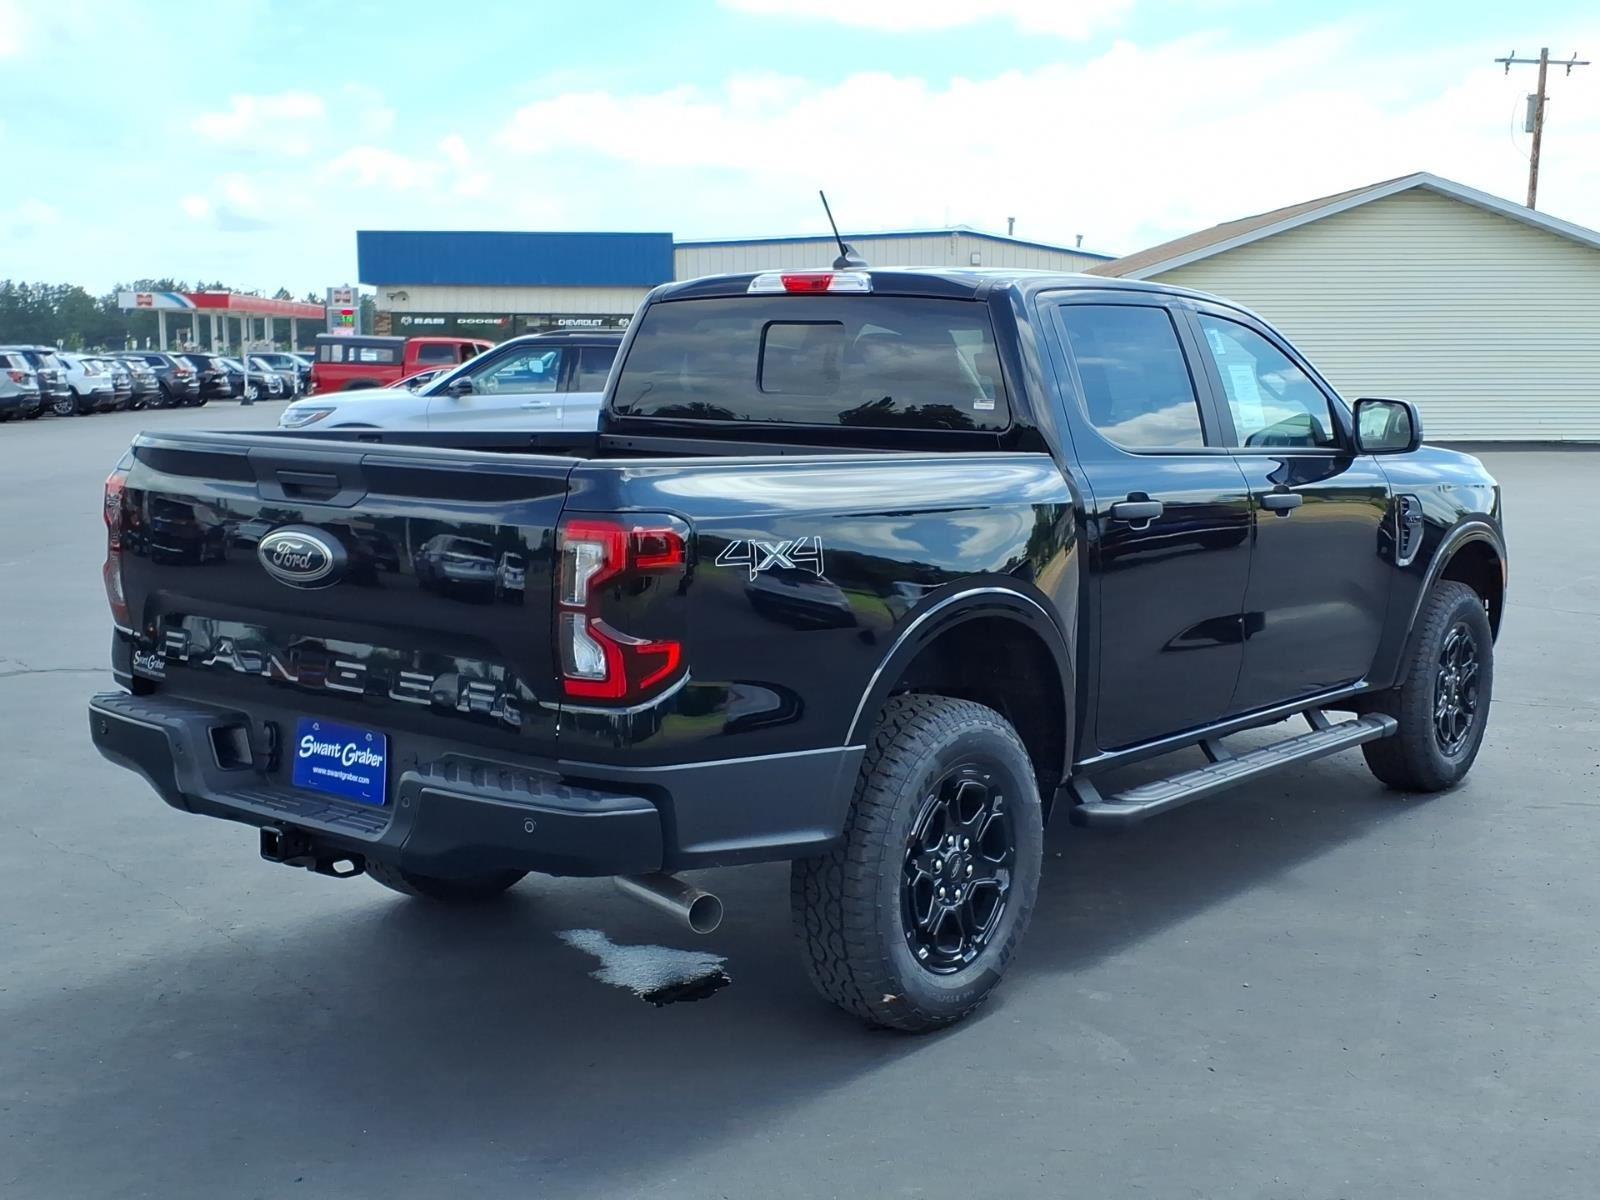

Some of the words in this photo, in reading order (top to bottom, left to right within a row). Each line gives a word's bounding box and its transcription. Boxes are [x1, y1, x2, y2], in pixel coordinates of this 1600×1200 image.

[414, 317, 445, 325] RAM
[557, 318, 603, 326] CHEVROLET
[273, 541, 312, 569] Ford
[133, 650, 148, 665] Swant
[156, 628, 505, 717] RANGER
[299, 735, 341, 758] Swant
[341, 743, 383, 768] Graber
[312, 766, 370, 785] www.swantgraber.com
